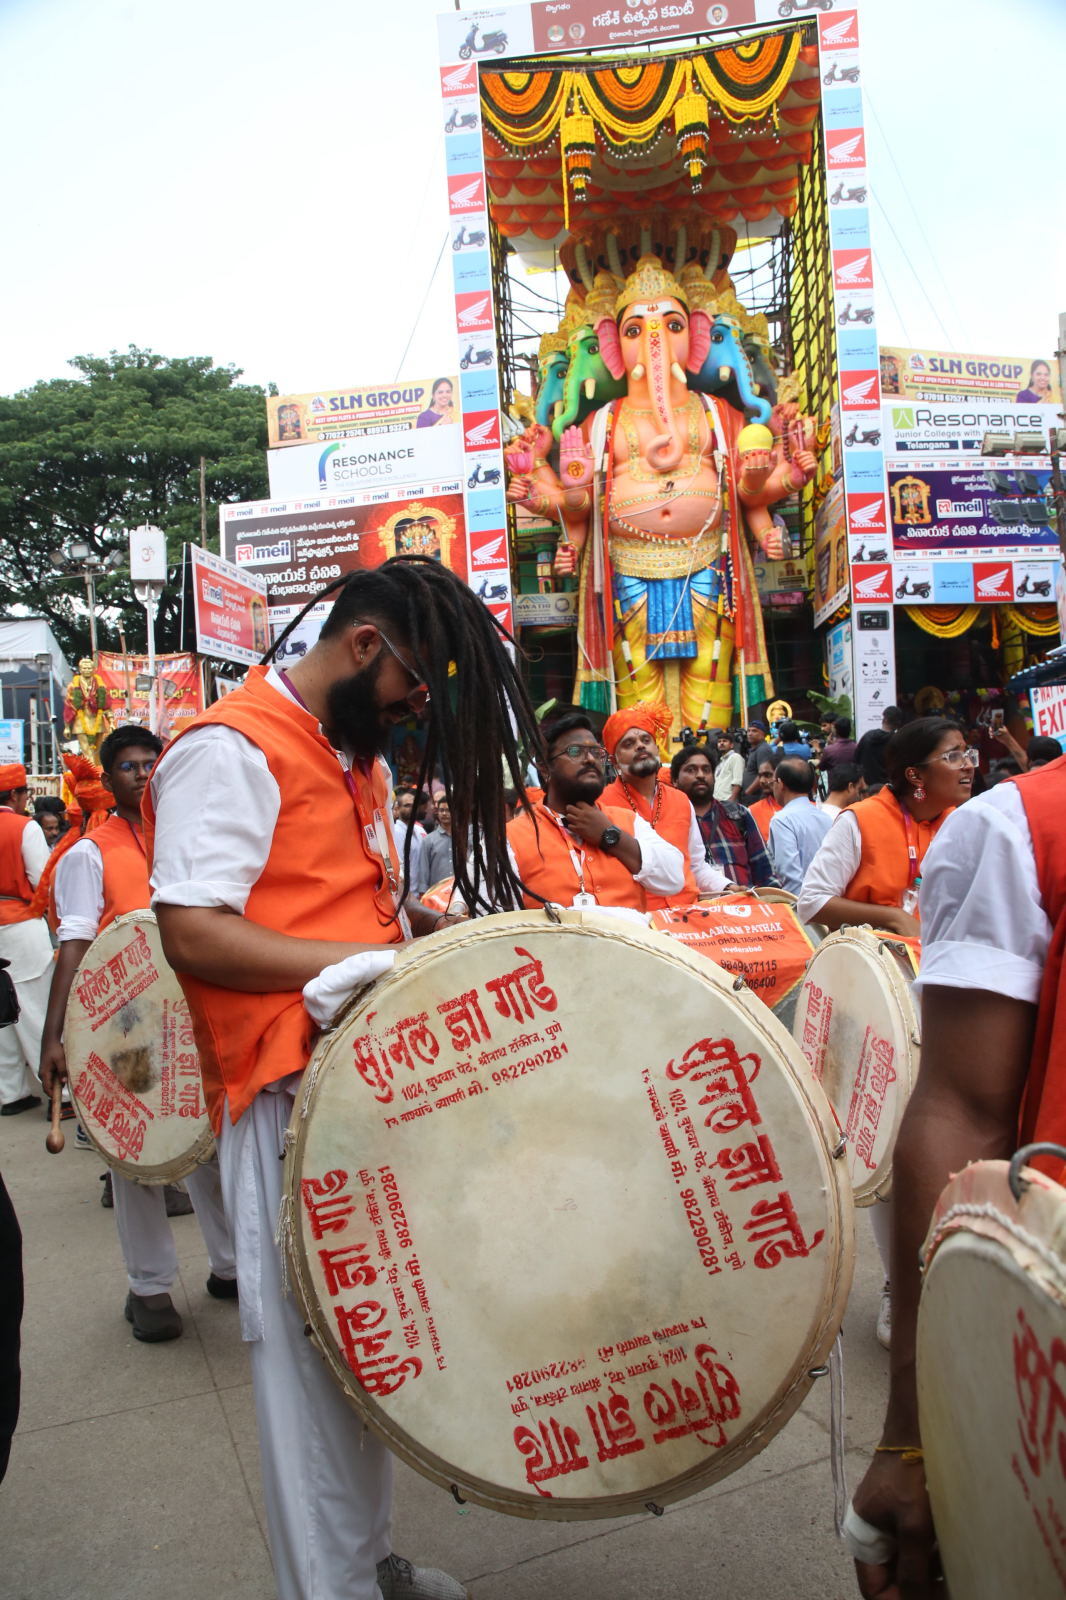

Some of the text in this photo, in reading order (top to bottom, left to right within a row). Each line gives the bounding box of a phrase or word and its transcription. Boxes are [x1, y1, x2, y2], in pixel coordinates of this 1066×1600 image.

[622, 8, 658, 26] ఉత్సవ
[660, 0, 694, 18] కమిటీ
[443, 83, 475, 92] HONDA
[830, 156, 864, 164] HONDA
[452, 201, 484, 209] HONDA
[459, 319, 491, 328] HONDA
[928, 358, 1023, 379] SLN GROUP
[329, 394, 362, 411] SLN
[366, 388, 424, 407] GROUP
[916, 410, 1042, 426] Resonance
[466, 438, 499, 446] HONDA
[924, 430, 961, 439] Colleges
[906, 441, 950, 450] Telangana
[332, 448, 415, 468] RESONANCE
[334, 464, 392, 480] SCHOOLS
[237, 482, 459, 518] meil meil meil meil meil meil meil
[954, 502, 982, 512] meil
[907, 524, 1040, 538] వినాయక చవితి శుభాకాంక్షలు
[256, 542, 289, 558] meil
[474, 557, 506, 565] HONDA
[310, 564, 341, 579] చవితి
[210, 587, 222, 601] meil
[270, 581, 327, 596] శుభాకాంక్షలు
[660, 922, 783, 940] MITRAANGAN PATHAK
[719, 937, 740, 945] DHOL
[484, 946, 558, 1024] गाडे
[545, 1022, 563, 1040] पुणे
[357, 1169, 375, 1187] पुणे
[742, 1191, 826, 1269] गाडे
[724, 1252, 746, 1270] पुणे
[511, 1396, 529, 1416] पुणे
[513, 1416, 590, 1498] गाडे
